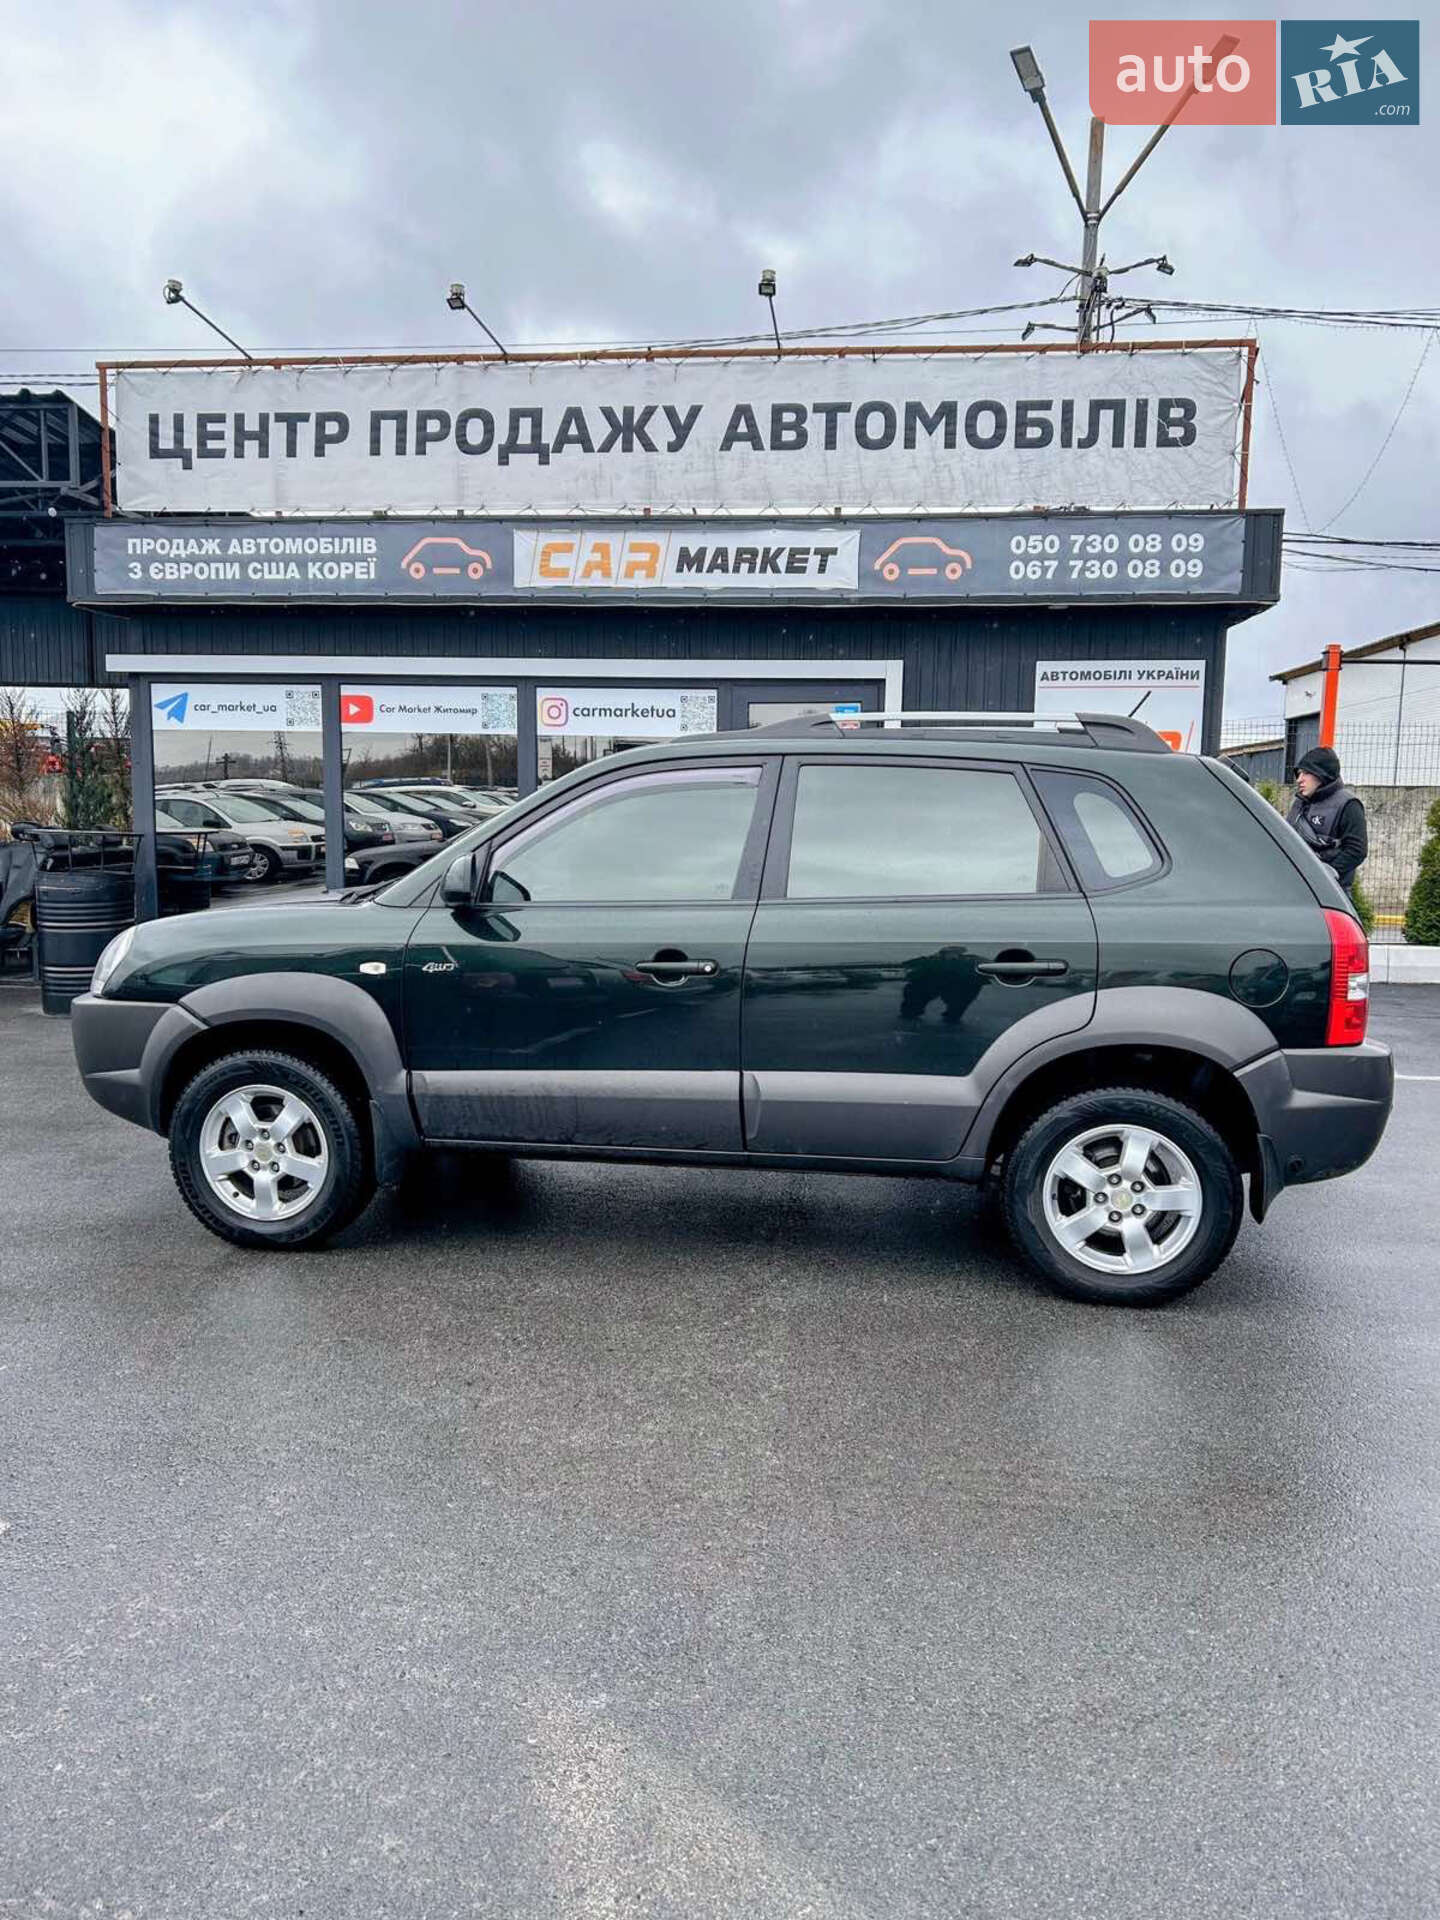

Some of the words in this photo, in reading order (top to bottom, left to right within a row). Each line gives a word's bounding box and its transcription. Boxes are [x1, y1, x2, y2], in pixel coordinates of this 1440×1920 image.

[149, 411, 350, 470] ЦЕНТР
[369, 404, 704, 466] ПРОДАЖУ
[719, 397, 1198, 452] АВТОМОБІЛІВ
[127, 537, 221, 558] ПРОДАЖ
[227, 537, 377, 555] АВТОМОБІЛІВ
[1009, 535, 1061, 555] 050
[1069, 534, 1120, 554] 730
[1128, 533, 1163, 553] 08
[1171, 533, 1205, 553] 09
[128, 561, 143, 580] З
[149, 561, 241, 580] ЄВРОПИ
[248, 561, 301, 580] США
[307, 557, 378, 580] КОРЕЇ
[538, 542, 662, 579] CAR
[675, 546, 839, 575] MARKET
[1009, 559, 1059, 580] 067
[1068, 559, 1119, 579] 730
[1127, 558, 1161, 578] 08
[1169, 558, 1204, 578] 09
[1040, 669, 1132, 681] АВТОМОБІЛІ
[1137, 667, 1201, 681] УКРАЇНИ
[193, 700, 278, 714] car_market_ua
[379, 703, 396, 714] Car
[398, 703, 431, 714] Market
[433, 705, 478, 717] Житомир
[572, 702, 677, 719] carmarketua
[422, 961, 456, 973] 4WD
